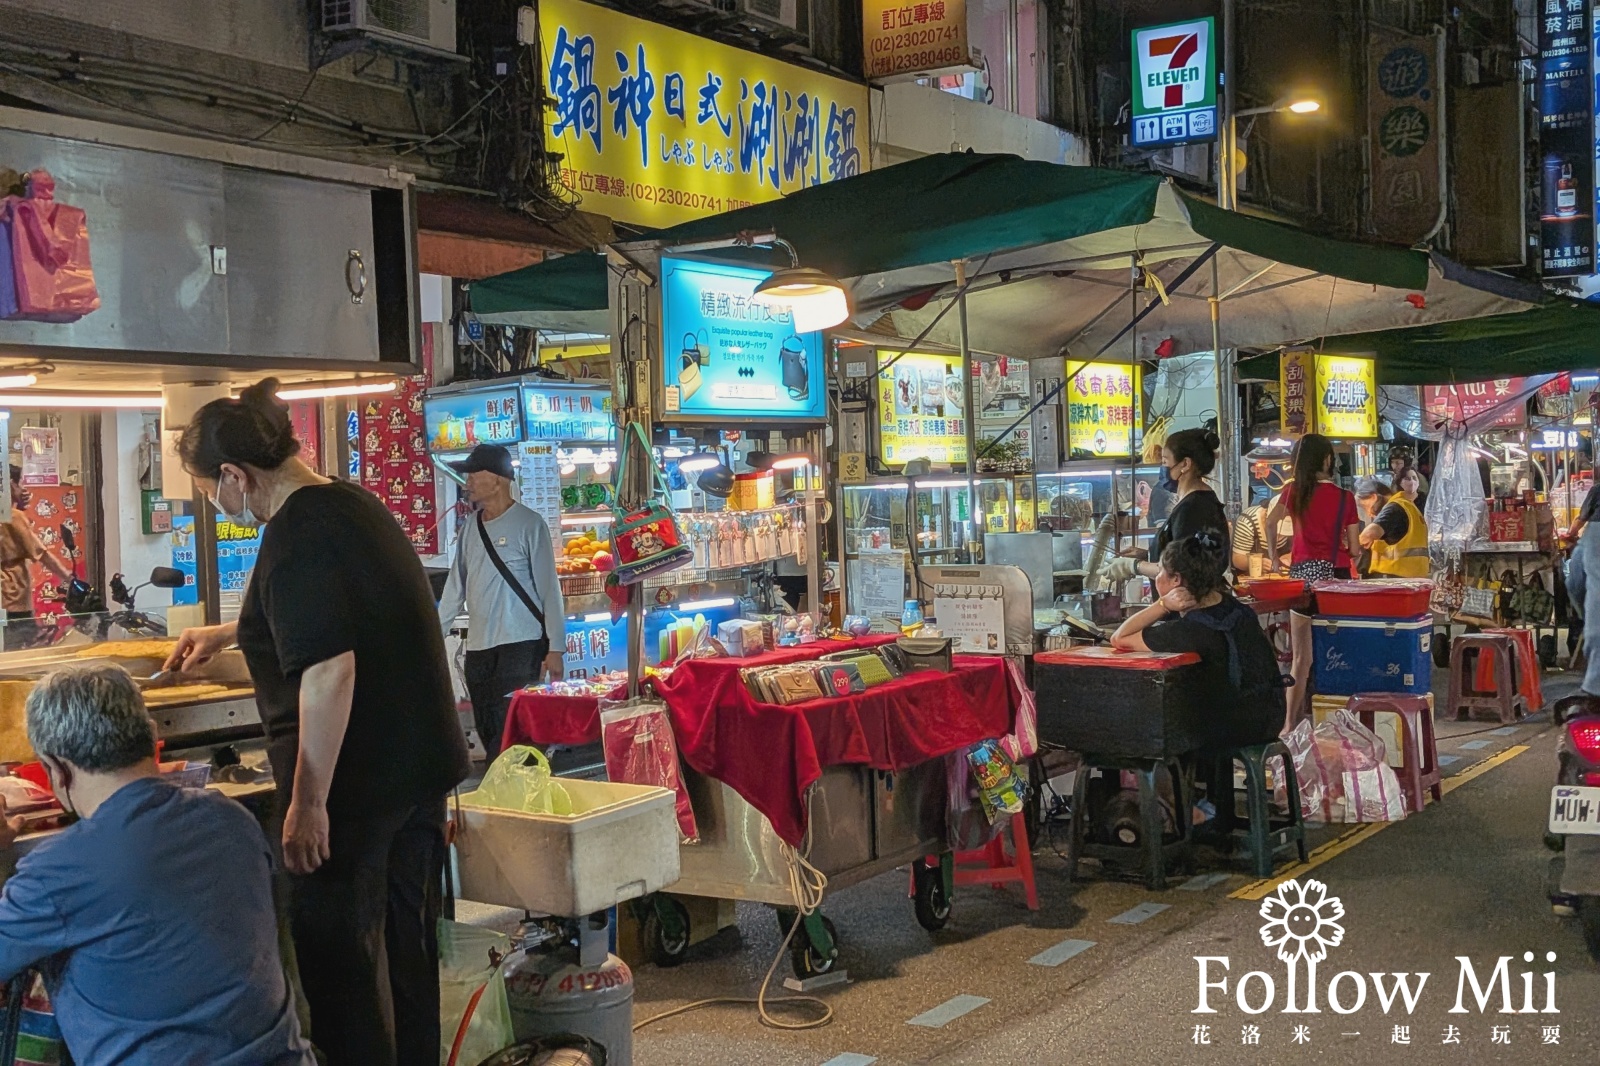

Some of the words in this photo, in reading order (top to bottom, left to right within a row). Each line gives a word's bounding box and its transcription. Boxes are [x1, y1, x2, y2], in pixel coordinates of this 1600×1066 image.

[881, 1, 946, 31] 訂位專線
[1545, 13, 1584, 34] 菸酒
[870, 24, 960, 57] (02)23020741
[1148, 31, 1198, 109] 7
[1545, 68, 1584, 80] MARTELL
[1166, 117, 1183, 126] ATM
[1287, 366, 1304, 413] 刮刮樂
[1327, 380, 1367, 407] 刮刮樂
[486, 396, 517, 418] 鮮榨
[487, 421, 518, 440] 果汁
[565, 630, 610, 662] 鮮榨
[1386, 663, 1400, 675] 36
[1554, 799, 1600, 823] MUW-
